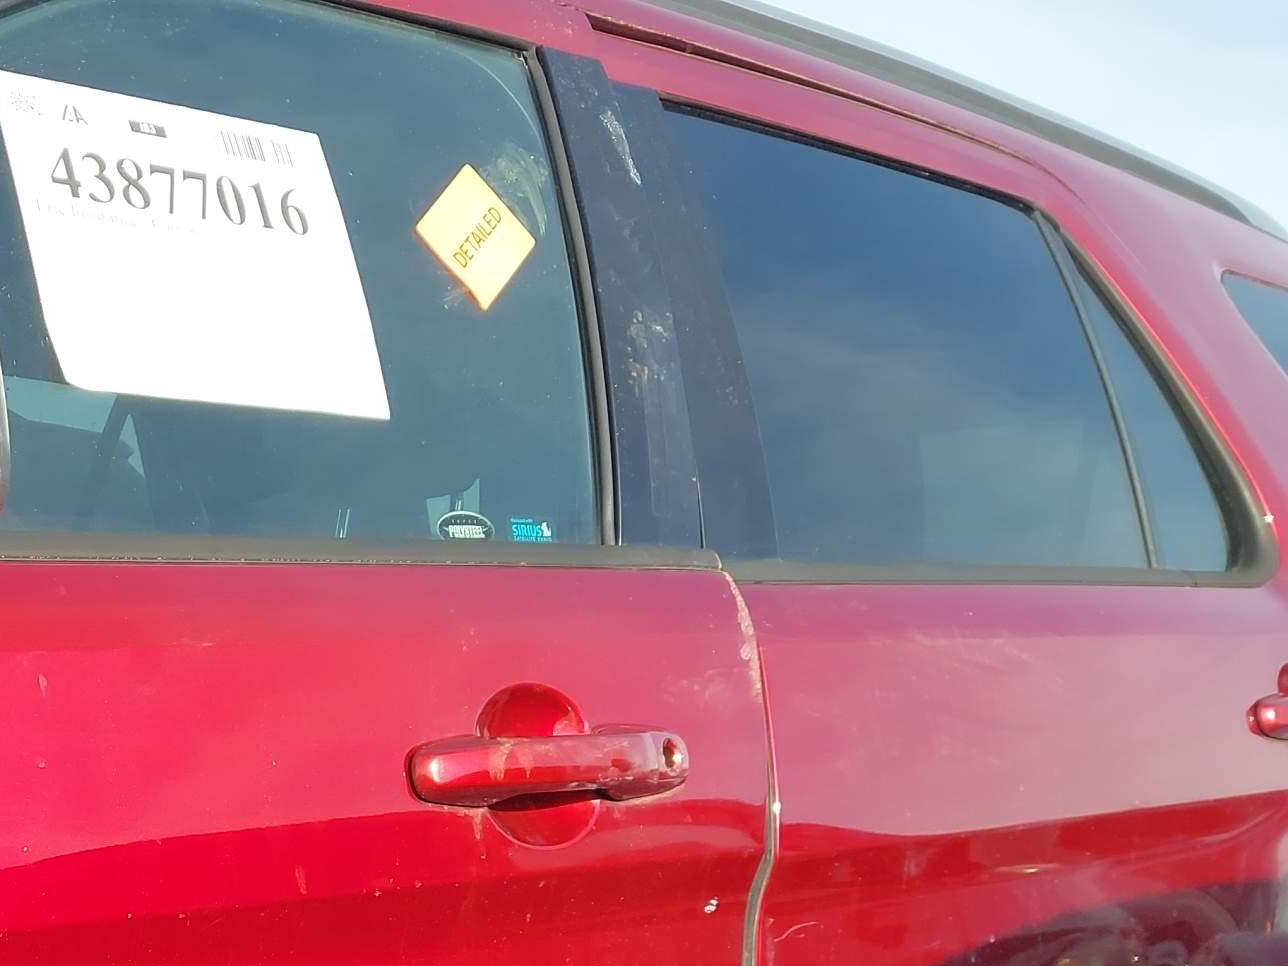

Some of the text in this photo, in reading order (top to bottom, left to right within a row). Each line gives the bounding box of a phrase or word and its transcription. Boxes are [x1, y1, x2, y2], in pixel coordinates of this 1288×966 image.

[50, 147, 309, 236] 43877016
[453, 207, 501, 268] DETAILED
[512, 524, 542, 537] SIRIUS
